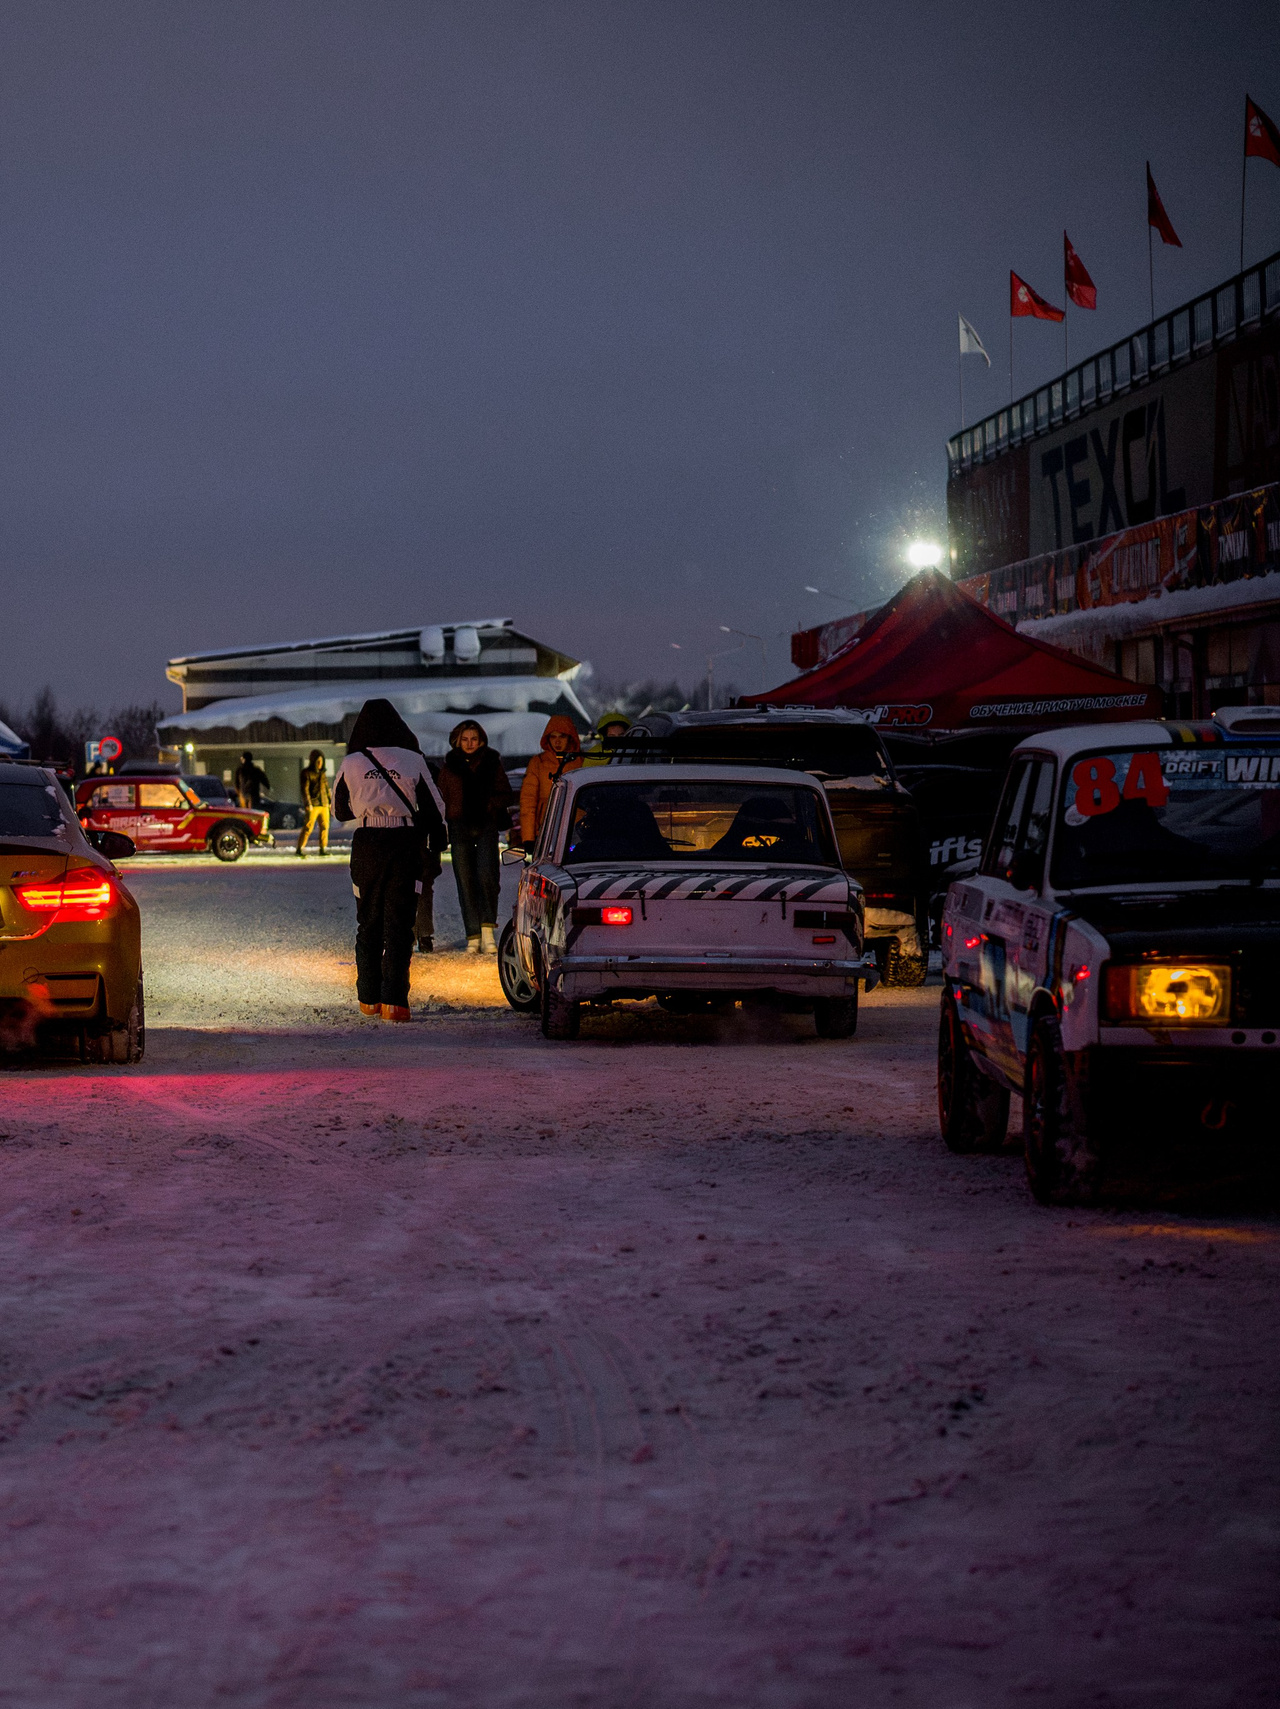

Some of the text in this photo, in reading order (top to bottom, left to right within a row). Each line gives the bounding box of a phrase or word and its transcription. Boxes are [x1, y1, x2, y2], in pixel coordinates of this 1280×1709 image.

[970, 702, 1033, 718] ОБУЧЕНИЕ
[1032, 698, 1086, 715] ДРИФТУ
[1095, 693, 1148, 709] МОСКВЕ
[1165, 761, 1221, 773] DRIFT
[1072, 752, 1170, 817] 84
